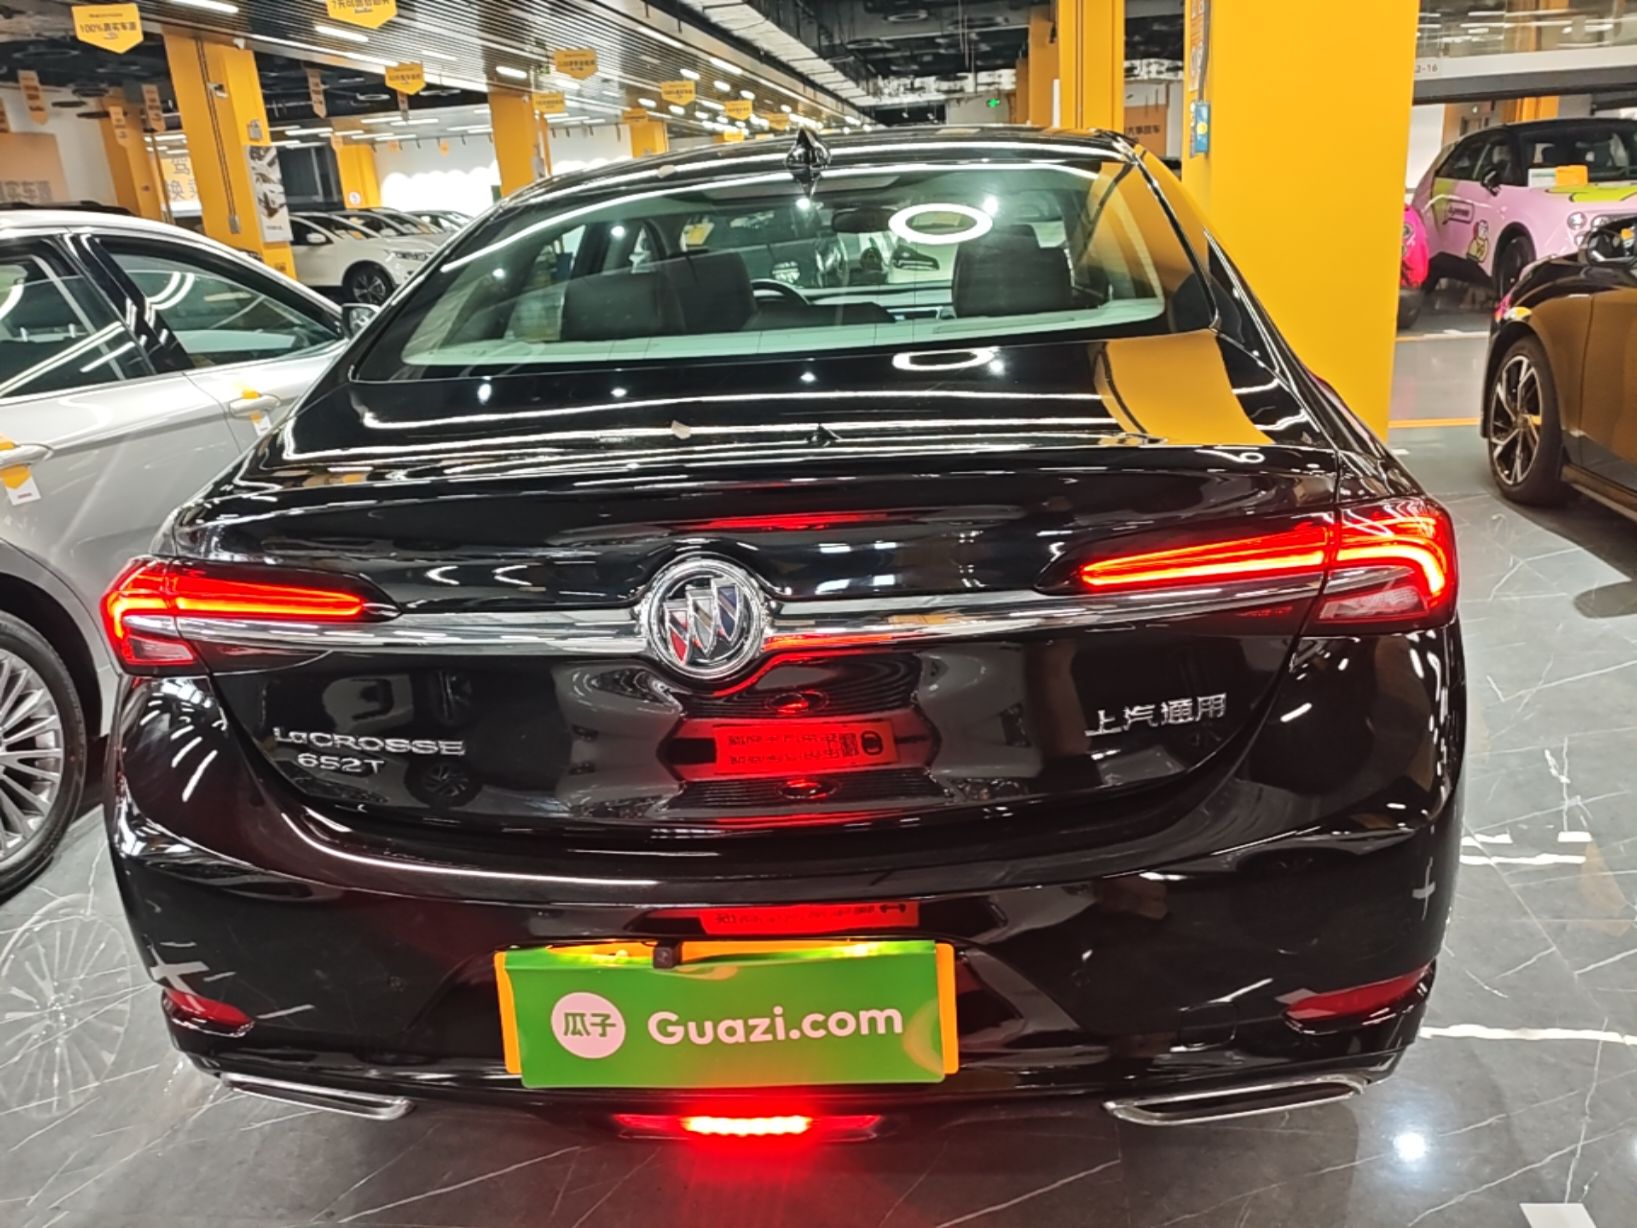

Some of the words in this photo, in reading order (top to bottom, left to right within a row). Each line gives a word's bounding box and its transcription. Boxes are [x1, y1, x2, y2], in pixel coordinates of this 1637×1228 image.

[1084, 692, 1227, 737] 上汽通用
[273, 726, 466, 757] LaCROSSE
[298, 752, 385, 774] 652T
[563, 1011, 617, 1039] 瓜子
[647, 1005, 903, 1046] Guazi.com
